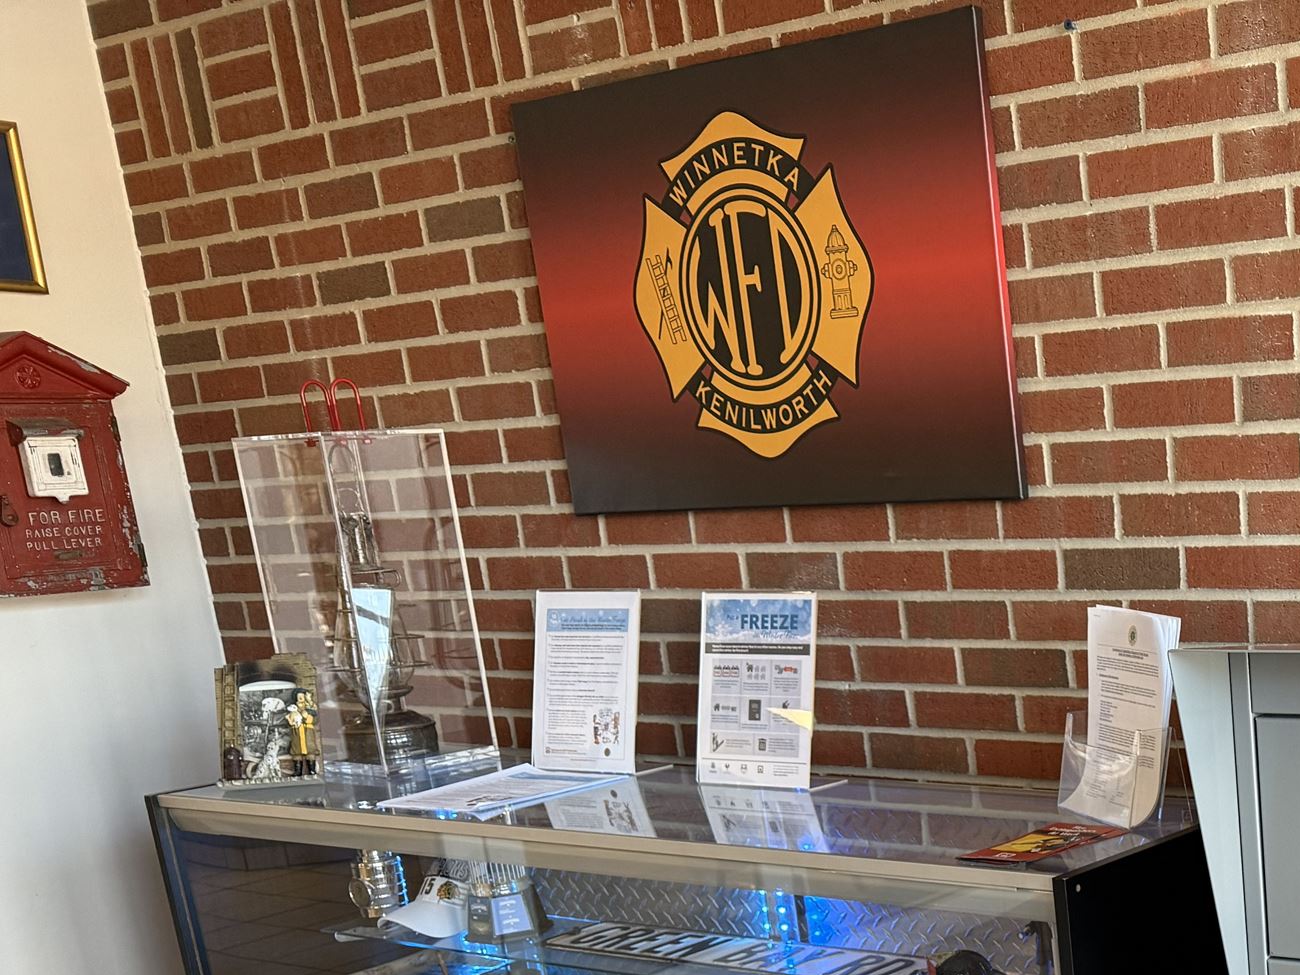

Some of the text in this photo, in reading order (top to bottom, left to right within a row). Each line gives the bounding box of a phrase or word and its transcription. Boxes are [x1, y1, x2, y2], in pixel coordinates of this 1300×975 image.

[669, 141, 801, 208] WINNETKA
[696, 200, 802, 376] WFD
[695, 370, 832, 430] KENILWORTH
[25, 525, 102, 539] RAISE COVER
[28, 509, 106, 526] FOR FIRE
[26, 537, 102, 551] PULL LEVER
[740, 614, 800, 630] FREEZE
[569, 925, 732, 959] GREEN
[712, 942, 843, 972] BAY
